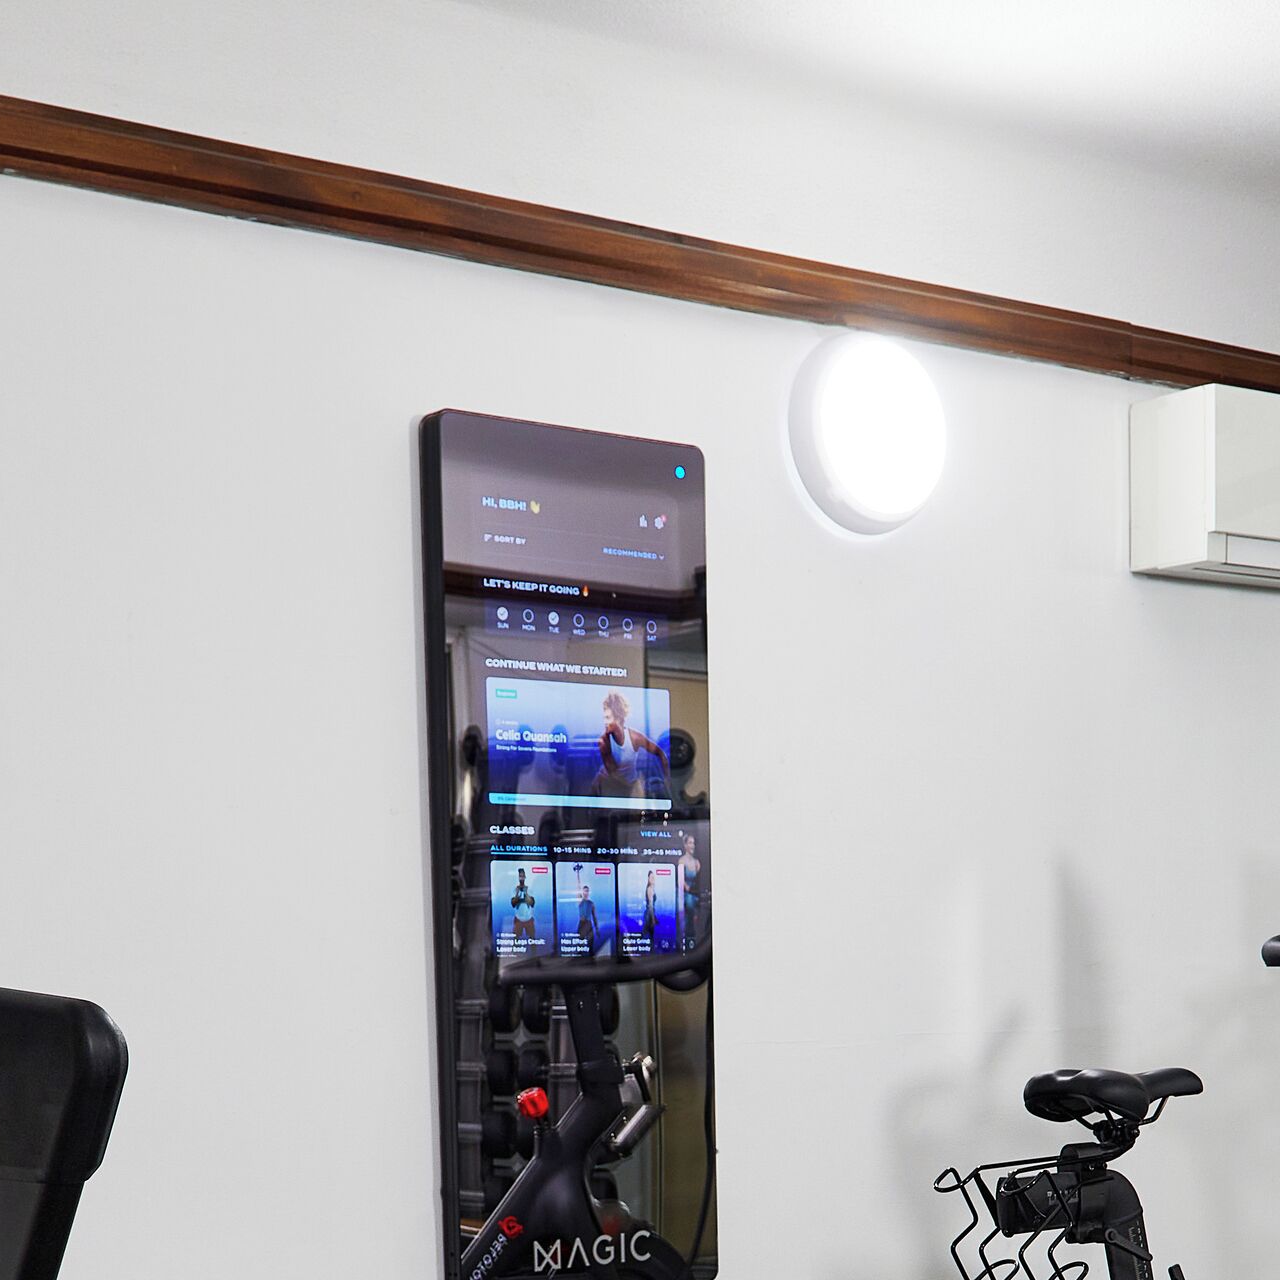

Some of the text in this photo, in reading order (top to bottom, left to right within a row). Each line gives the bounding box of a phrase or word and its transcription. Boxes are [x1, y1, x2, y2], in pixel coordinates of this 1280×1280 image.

[494, 535, 515, 543] SORT
[602, 547, 657, 560] RECOMMENDED
[483, 578, 580, 596] LET'S KEEP IT GOING
[497, 621, 509, 630] SUN
[521, 624, 536, 632] MON
[548, 626, 560, 634] TUE
[572, 628, 586, 636] WED
[598, 630, 610, 638] THU
[485, 658, 628, 677] CONTINUE WHAT WE STARTED!
[496, 729, 567, 744] Celia Quansah
[489, 825, 535, 835] CLASSES
[640, 830, 658, 838] VIEW
[490, 844, 548, 853] ALL DURATIONS
[573, 847, 592, 855] MINS
[596, 847, 619, 855] 20-30
[532, 1229, 652, 1273] MAGIC
